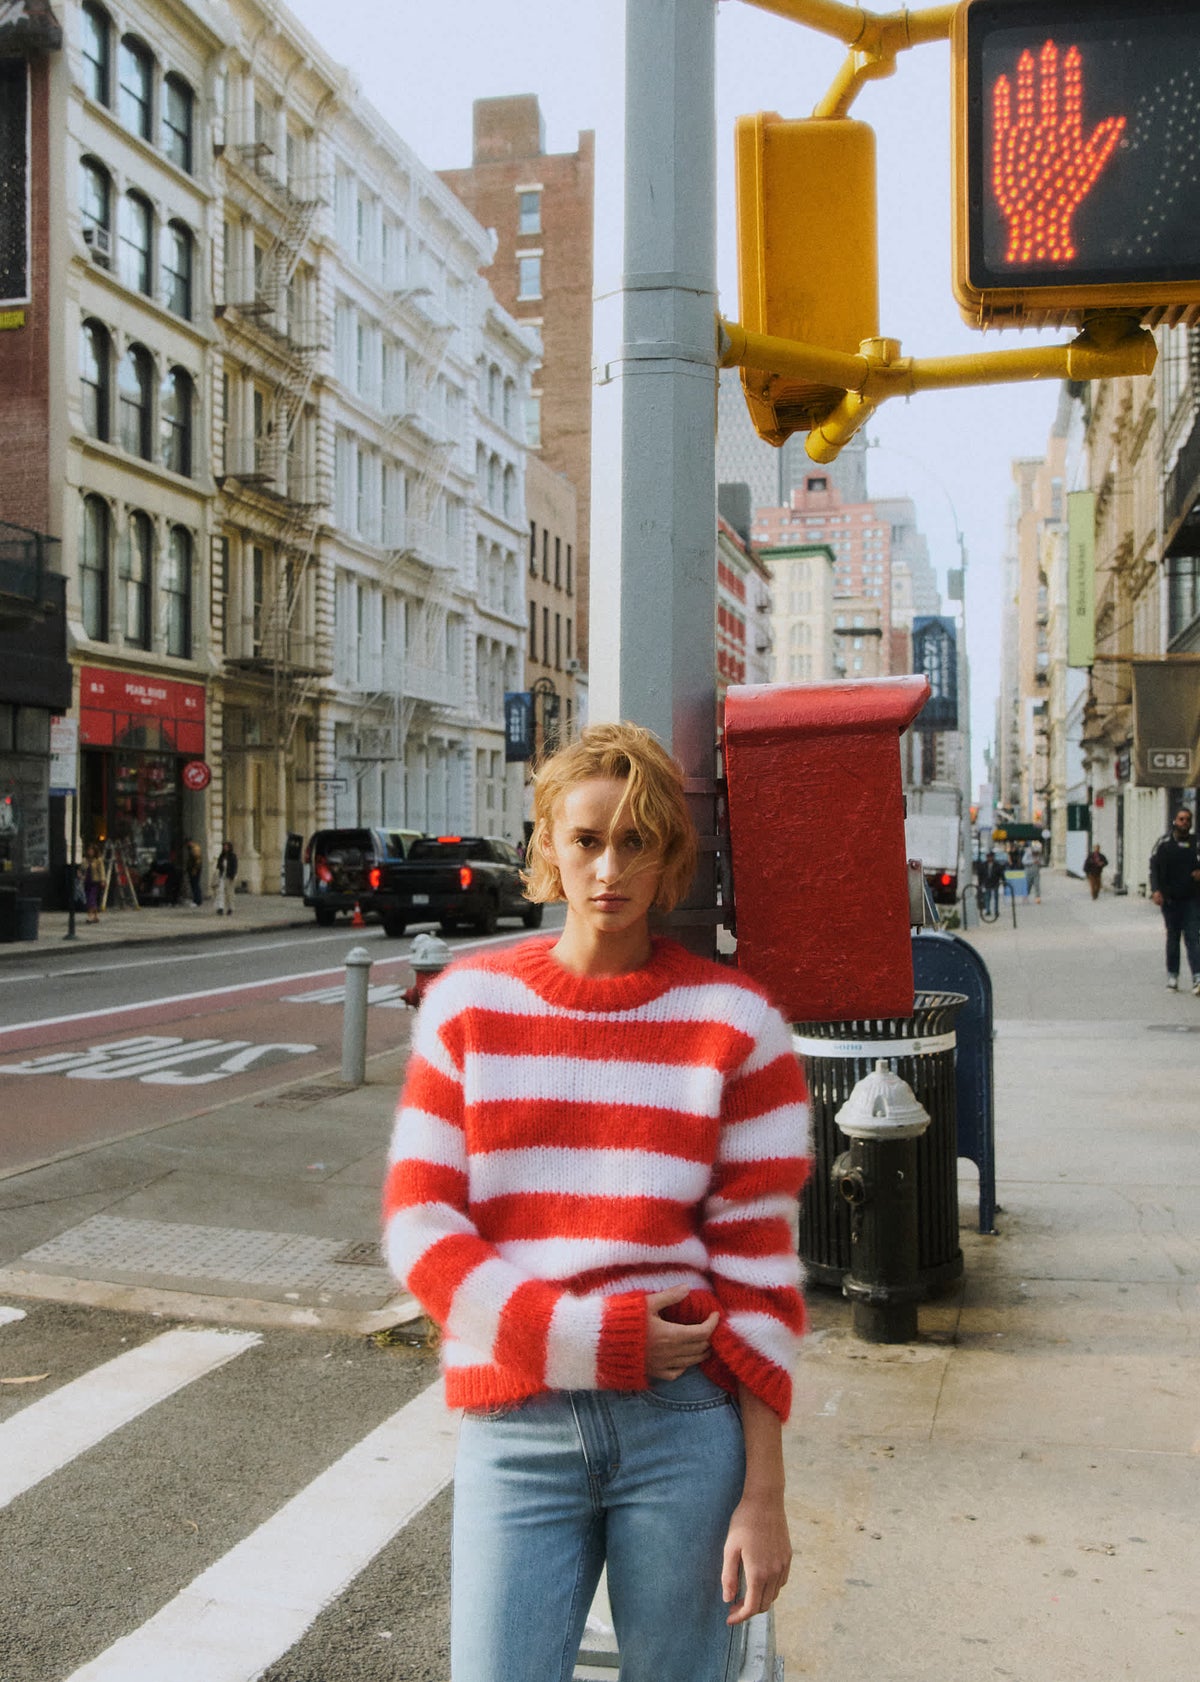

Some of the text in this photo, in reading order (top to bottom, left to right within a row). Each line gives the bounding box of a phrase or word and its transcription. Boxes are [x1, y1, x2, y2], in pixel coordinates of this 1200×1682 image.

[125, 684, 166, 699] PEARL RIVER
[1153, 753, 1187, 768] CB2
